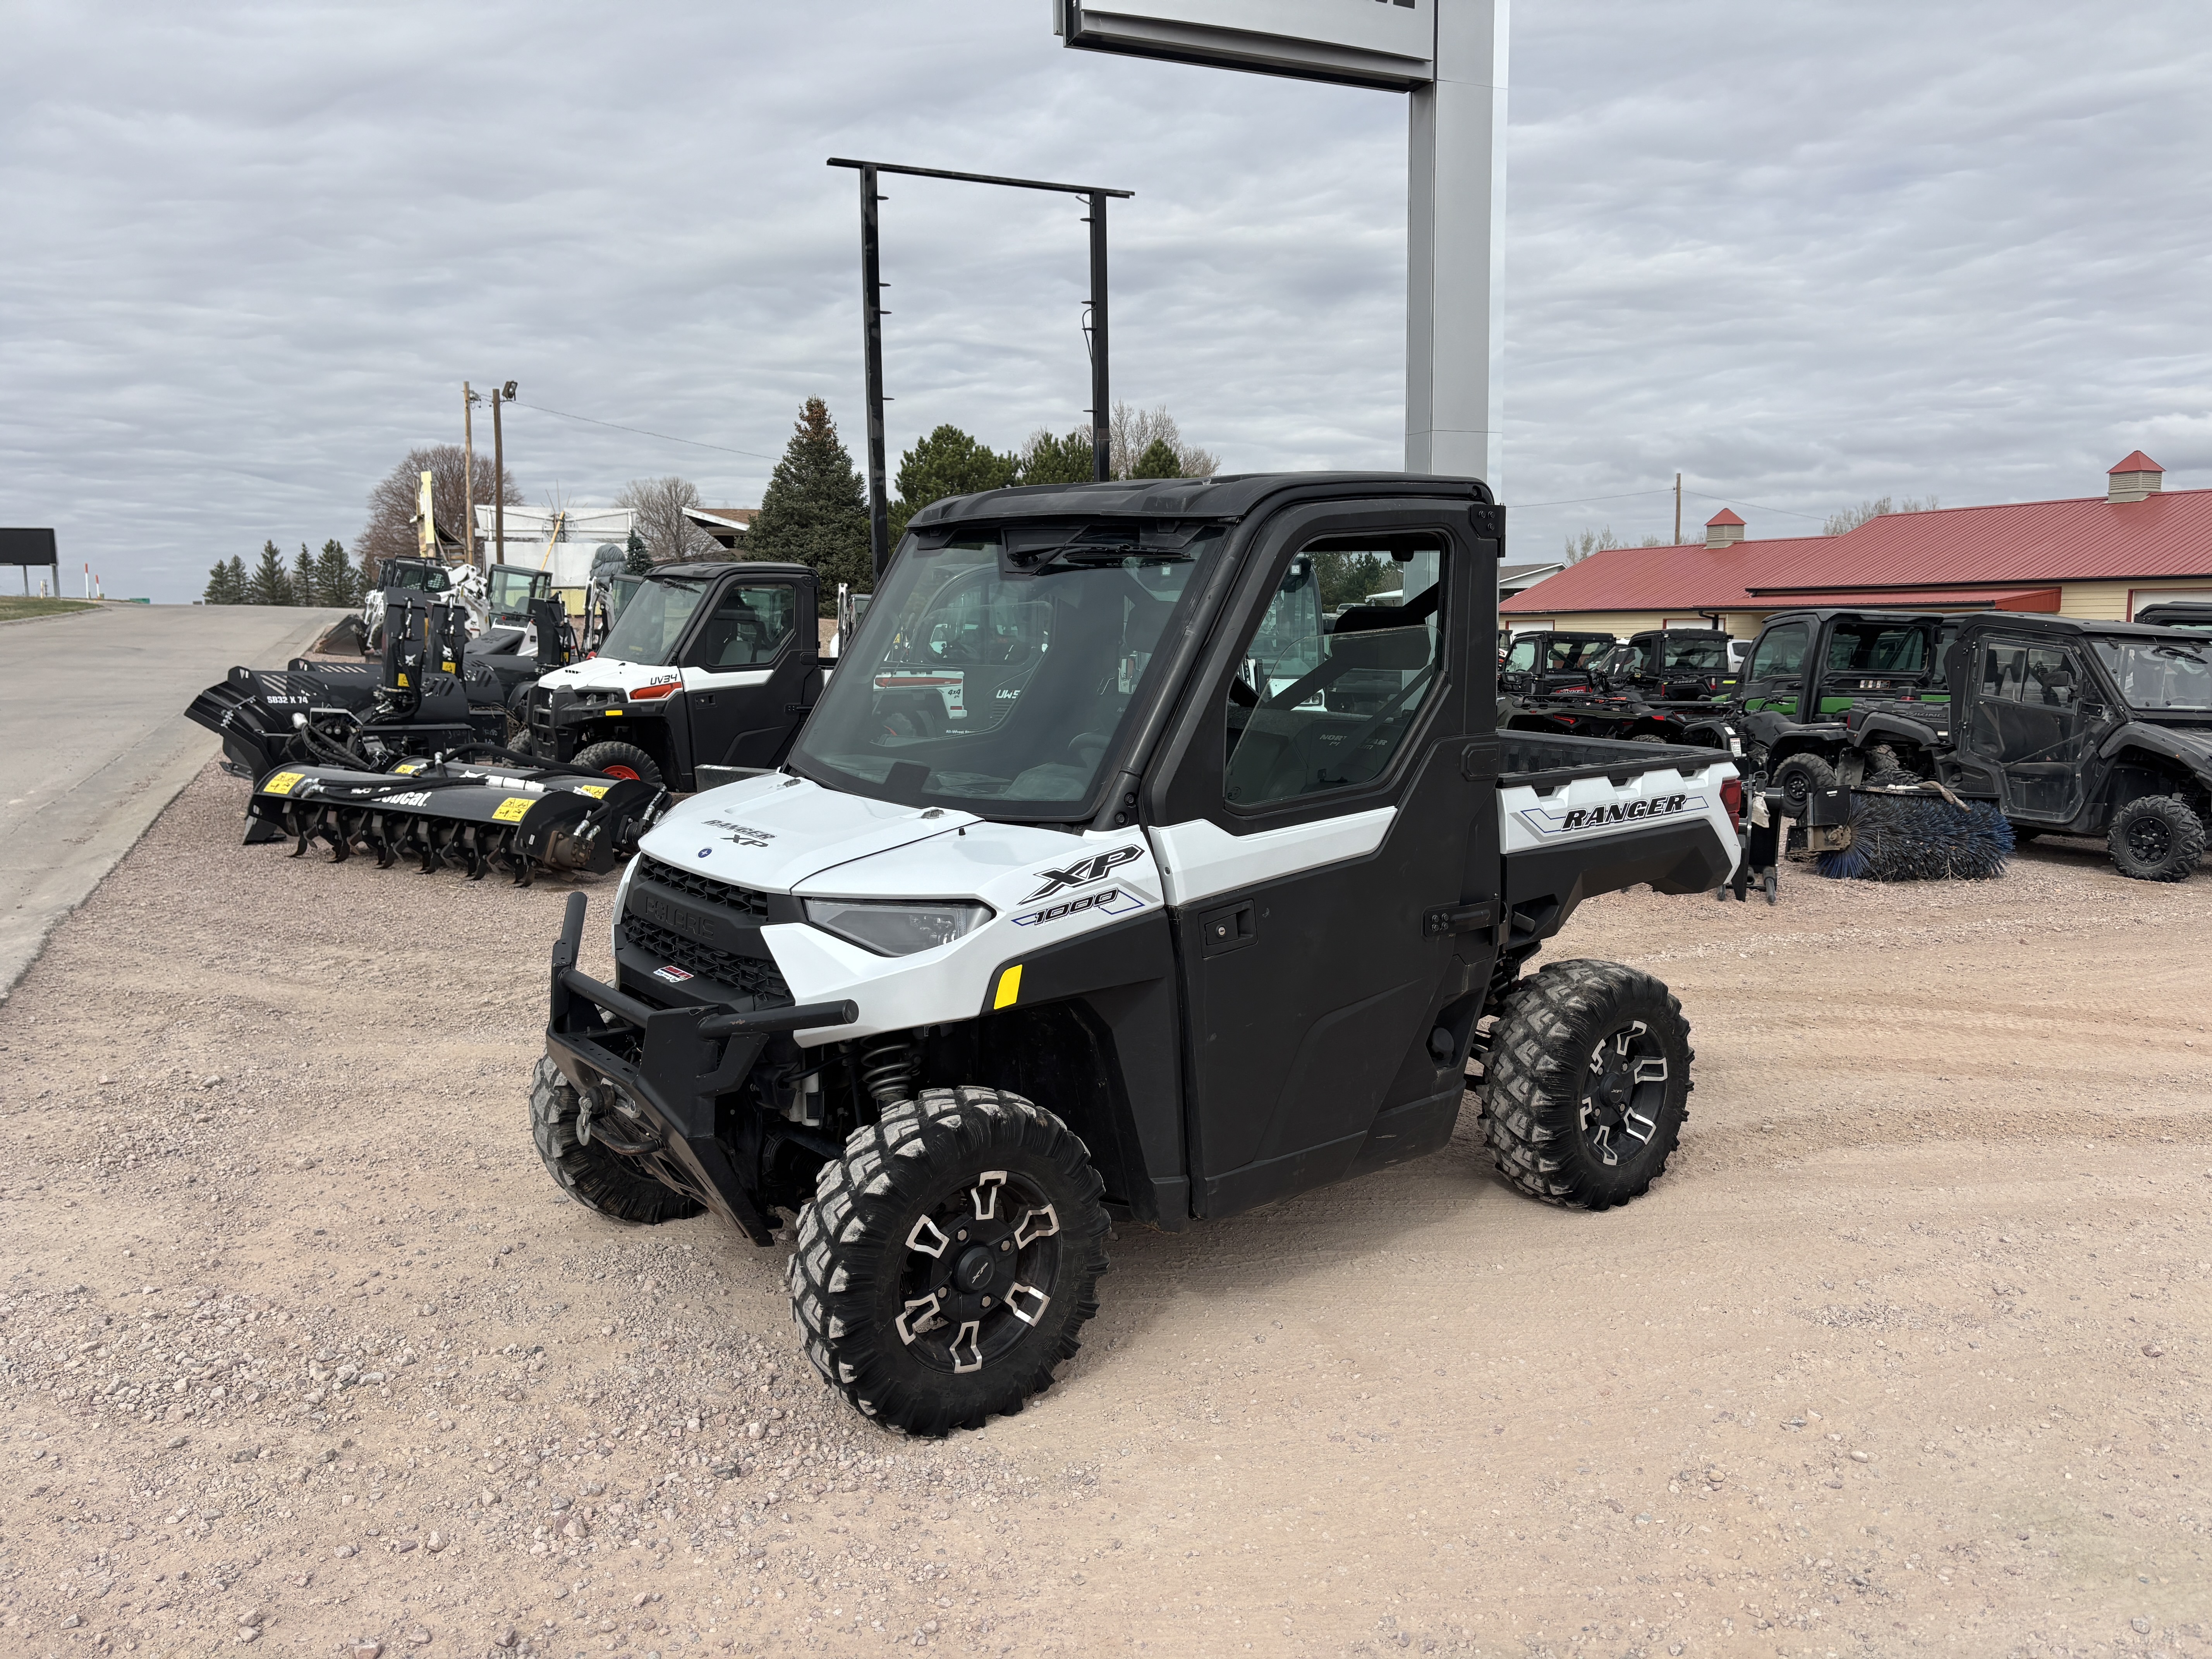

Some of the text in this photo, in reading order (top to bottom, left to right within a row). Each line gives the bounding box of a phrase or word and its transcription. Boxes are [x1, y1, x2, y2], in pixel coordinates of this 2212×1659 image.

[650, 673, 677, 685] UV34
[297, 696, 309, 704] 74
[1561, 792, 1687, 832] RANGER
[700, 819, 778, 840] RANGER
[718, 834, 769, 847] XP
[1017, 844, 1145, 905] XP
[1034, 888, 1119, 925] 1000
[645, 896, 715, 940] POLARIS
[972, 1262, 989, 1284] XP
